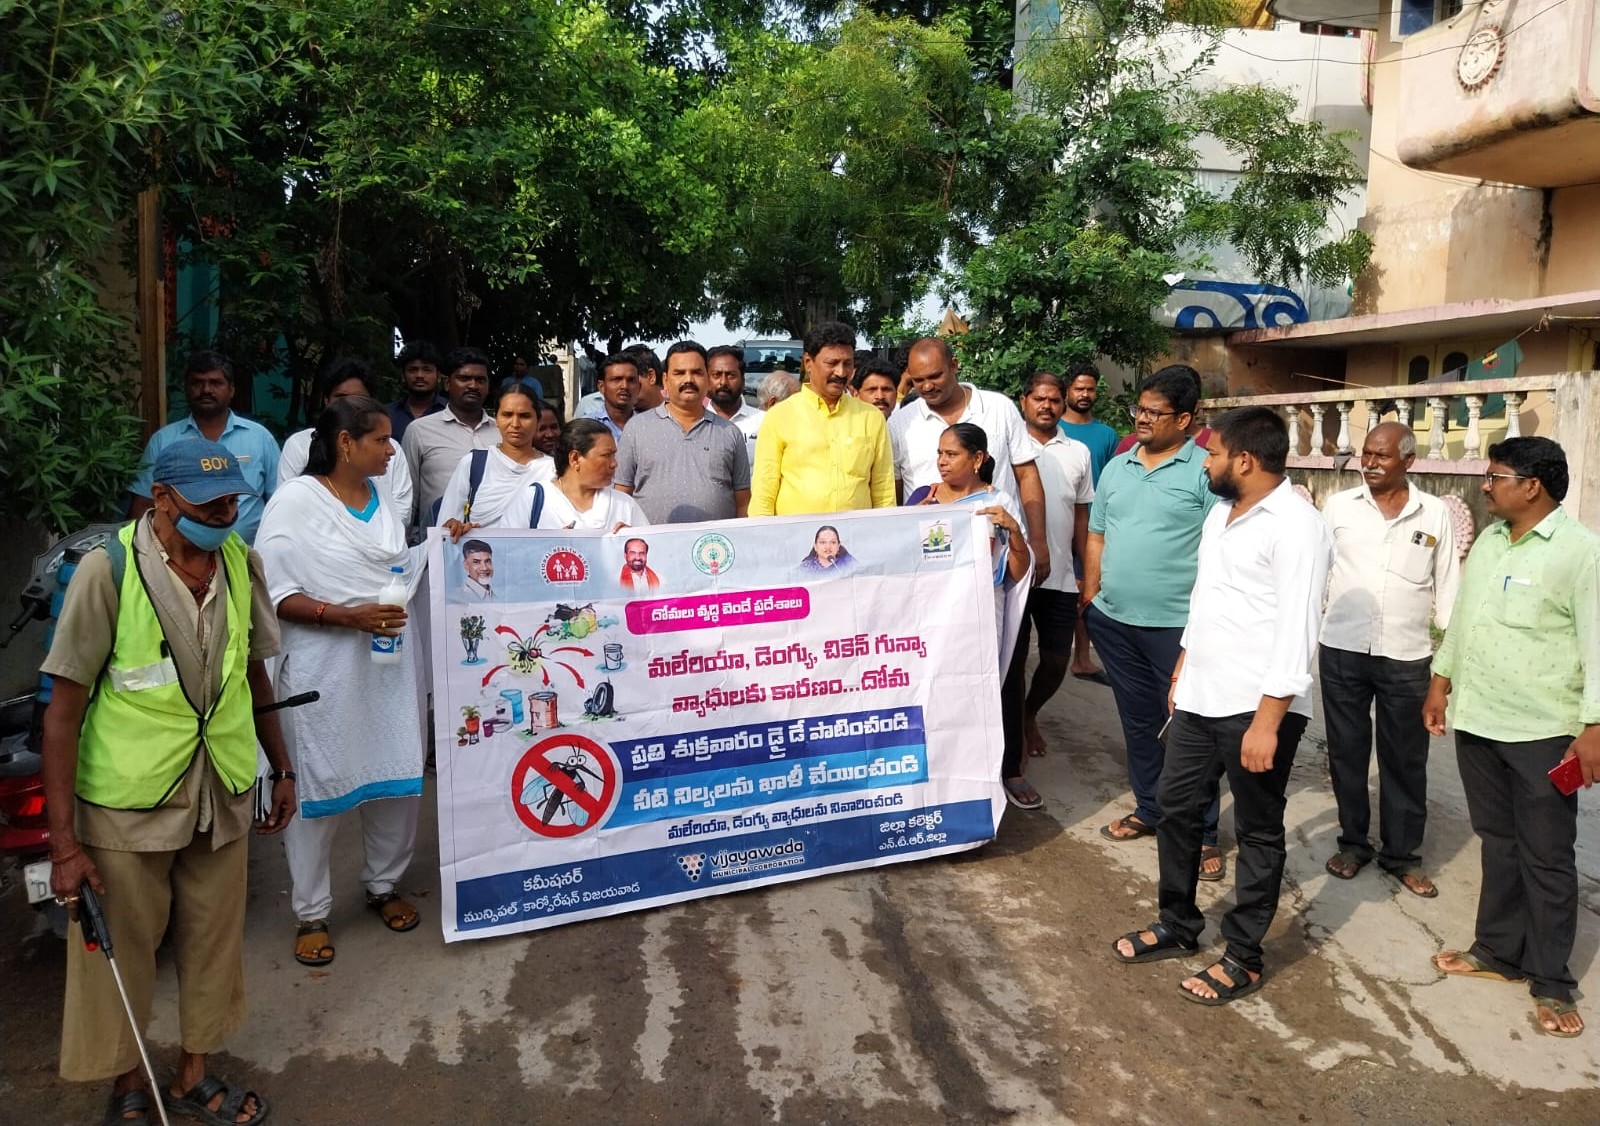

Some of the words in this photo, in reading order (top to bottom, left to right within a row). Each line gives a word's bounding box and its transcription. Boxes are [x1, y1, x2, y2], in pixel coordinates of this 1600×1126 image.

[200, 457, 228, 471] BOY
[651, 604, 694, 621] దోమలు
[697, 604, 719, 623] వృద్ధి
[723, 598, 751, 614] చెందే
[754, 595, 802, 616] ప్రదేశాలు
[824, 634, 869, 659] చికెన్
[875, 634, 927, 658] గున్యా
[672, 683, 766, 718] వ్యాధులకు
[631, 743, 666, 771] ప్రతి
[671, 731, 763, 762] శుక్రవారం
[768, 726, 786, 759] డ్రై
[789, 719, 805, 743] డే
[809, 712, 909, 741] పాటించండి
[633, 787, 669, 812] నీటి
[674, 776, 754, 808] నిల్వలను
[759, 764, 804, 794] ఖాళీ
[809, 755, 919, 785] చేయించండి
[772, 803, 828, 826] వ్యాధులను
[830, 793, 903, 815] నివారించండి
[880, 820, 906, 834] జిల్లా
[908, 810, 943, 831] కలెక్టర్
[710, 838, 804, 868] vijayawada
[711, 866, 752, 878] MUNICIPAL
[753, 856, 805, 872] CORPORATION
[523, 867, 583, 892] కమీషనర్
[463, 901, 518, 923] మున్సిపల్
[582, 881, 641, 902] విజయవాడ
